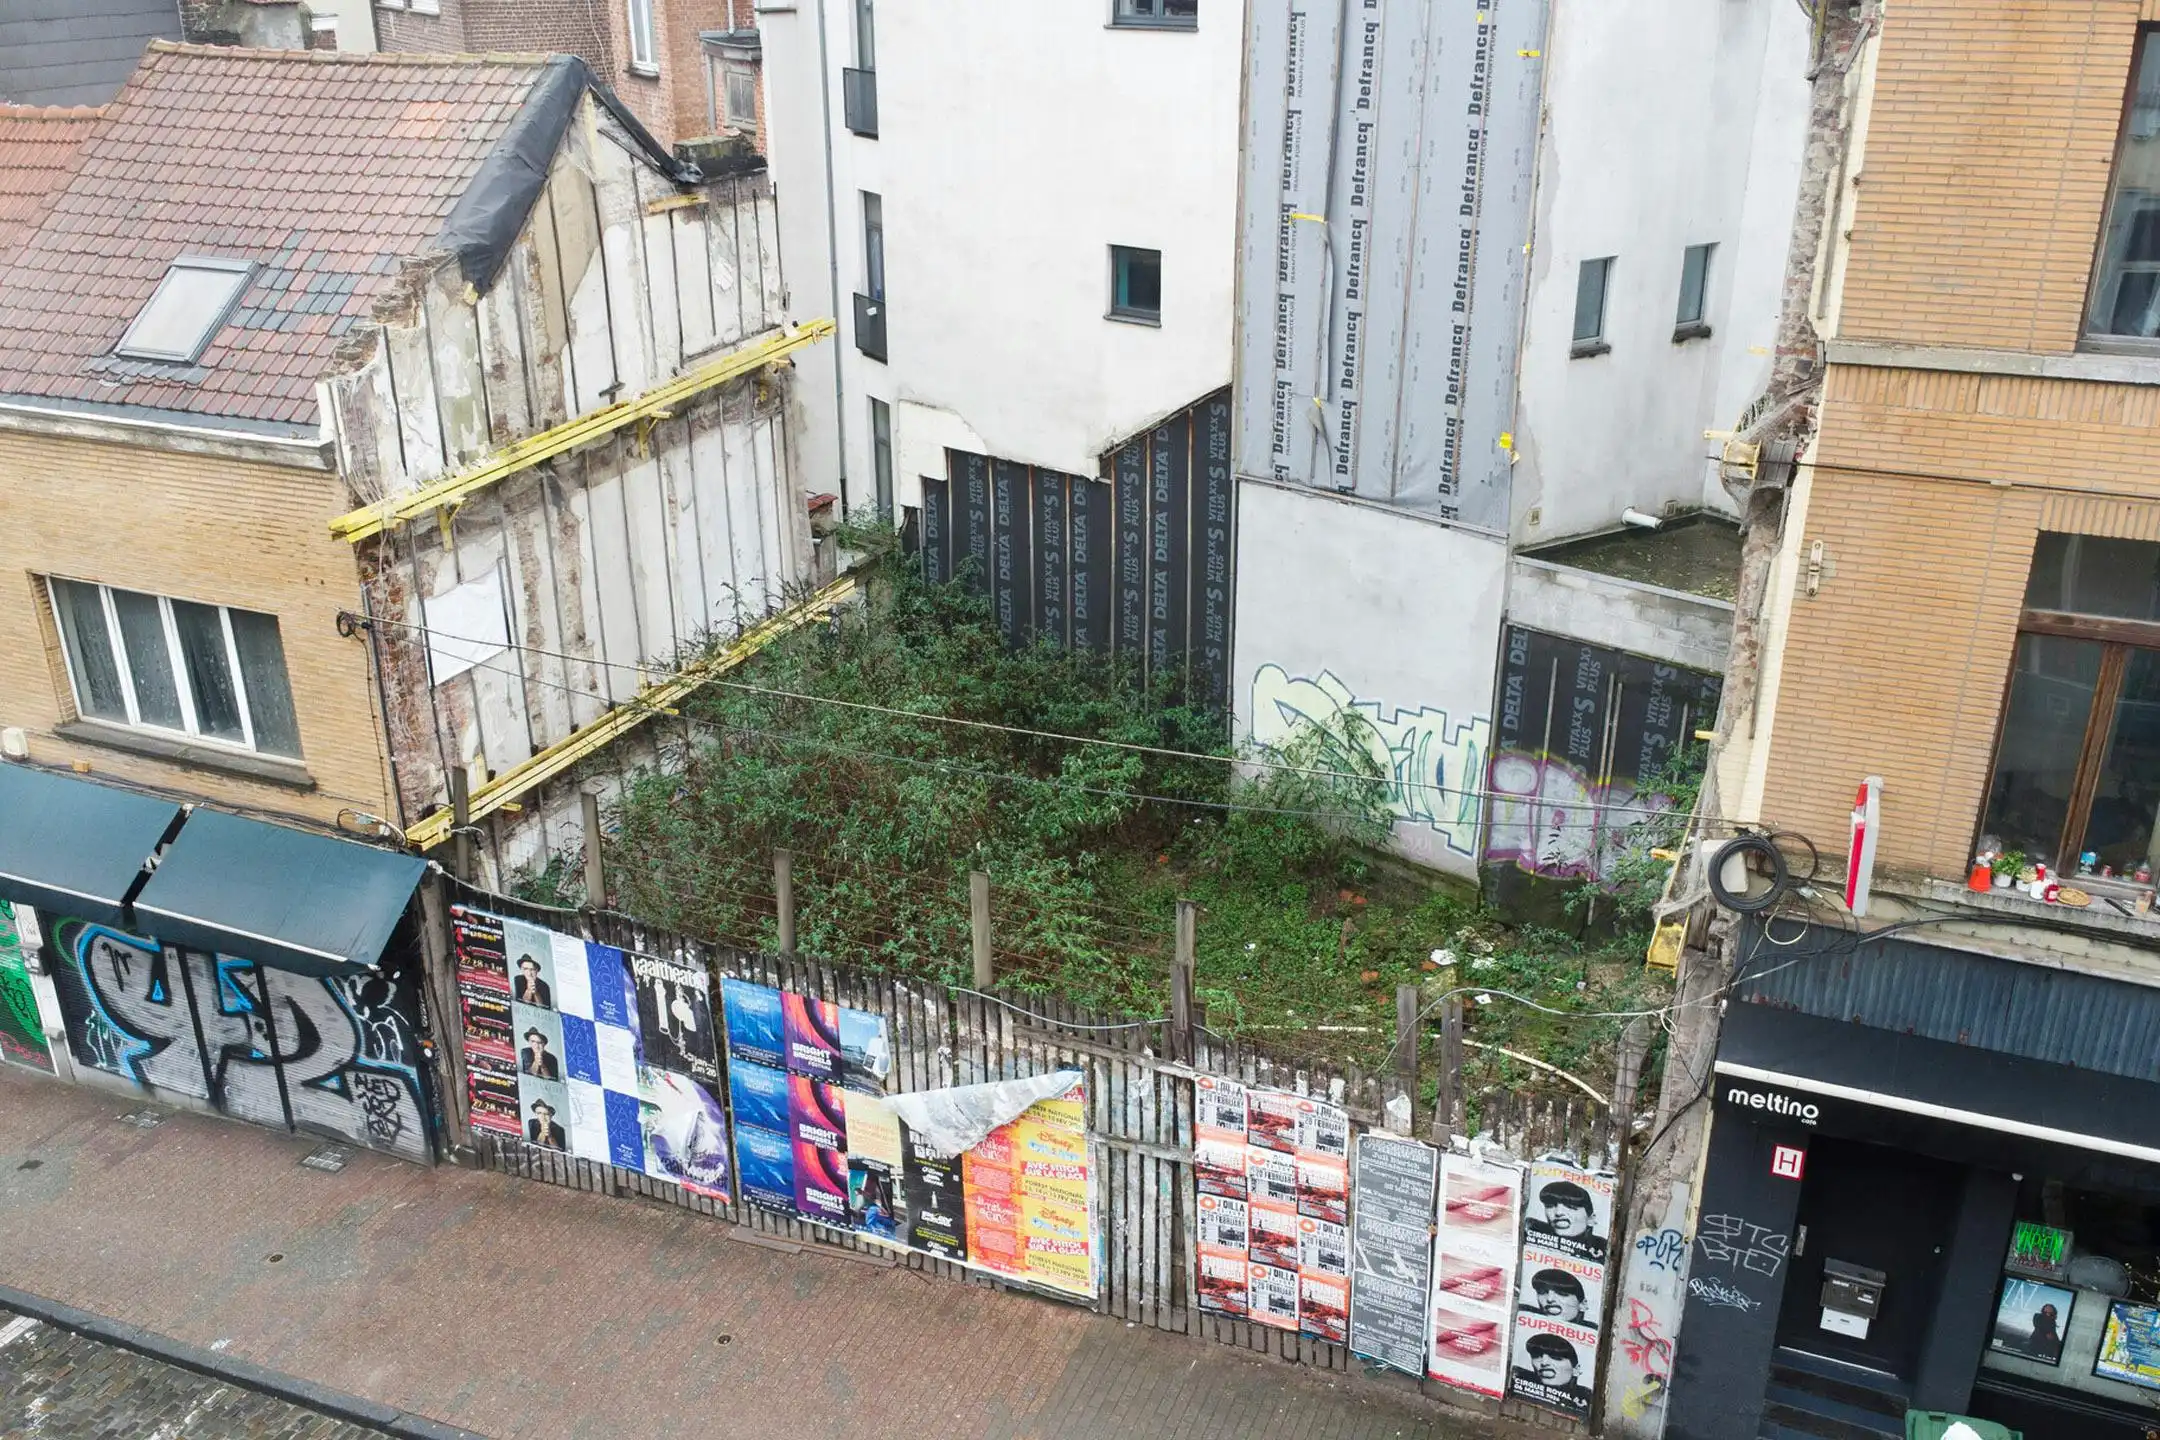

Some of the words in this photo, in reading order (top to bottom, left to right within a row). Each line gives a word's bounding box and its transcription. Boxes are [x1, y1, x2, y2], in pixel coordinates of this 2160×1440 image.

[1357, 22, 1380, 109] Defrancq
[1350, 122, 1374, 206] Defrancq
[1345, 219, 1368, 299] Defrancq
[1276, 293, 1295, 369] Defrancq
[1341, 312, 1362, 389] Defrancq
[1272, 380, 1292, 454] Defrancq
[1335, 400, 1357, 475] Defrancq
[1218, 432, 1226, 460] PLUS
[1438, 418, 1459, 494] Defrancq
[976, 479, 984, 505] PLUS
[1154, 451, 1169, 502] DELTA
[928, 493, 937, 538] DELTA
[998, 479, 1010, 526] DELTA
[1131, 499, 1139, 526] PLUS
[1217, 494, 1226, 521] PLUS
[999, 534, 1011, 580] DELTA
[1075, 515, 1087, 562] DELTA
[1154, 511, 1168, 561] DELTA
[1131, 558, 1139, 583] PLUS
[1215, 554, 1224, 582] PLUS
[1000, 588, 1011, 633] DELTA
[1075, 571, 1088, 618] DELTA
[1153, 570, 1168, 619] DELTA
[1131, 614, 1139, 640] PLUS
[1587, 660, 1601, 693] PLUS
[1503, 675, 1523, 731] DELTA
[1658, 695, 1672, 728] PLUS
[1579, 728, 1592, 758] PLUS
[1728, 1088, 1819, 1119] meltino
[1778, 1151, 1797, 1173] H
[1527, 1230, 1559, 1243] CIRQUE
[1560, 1237, 1588, 1251] ROYAL
[1537, 1239, 1559, 1249] MARS
[1518, 1316, 1596, 1345] SUPERBUS
[1514, 1378, 1545, 1391] CIRQUE
[1546, 1386, 1572, 1400] ROYAL
[1524, 1386, 1545, 1397] MARS
